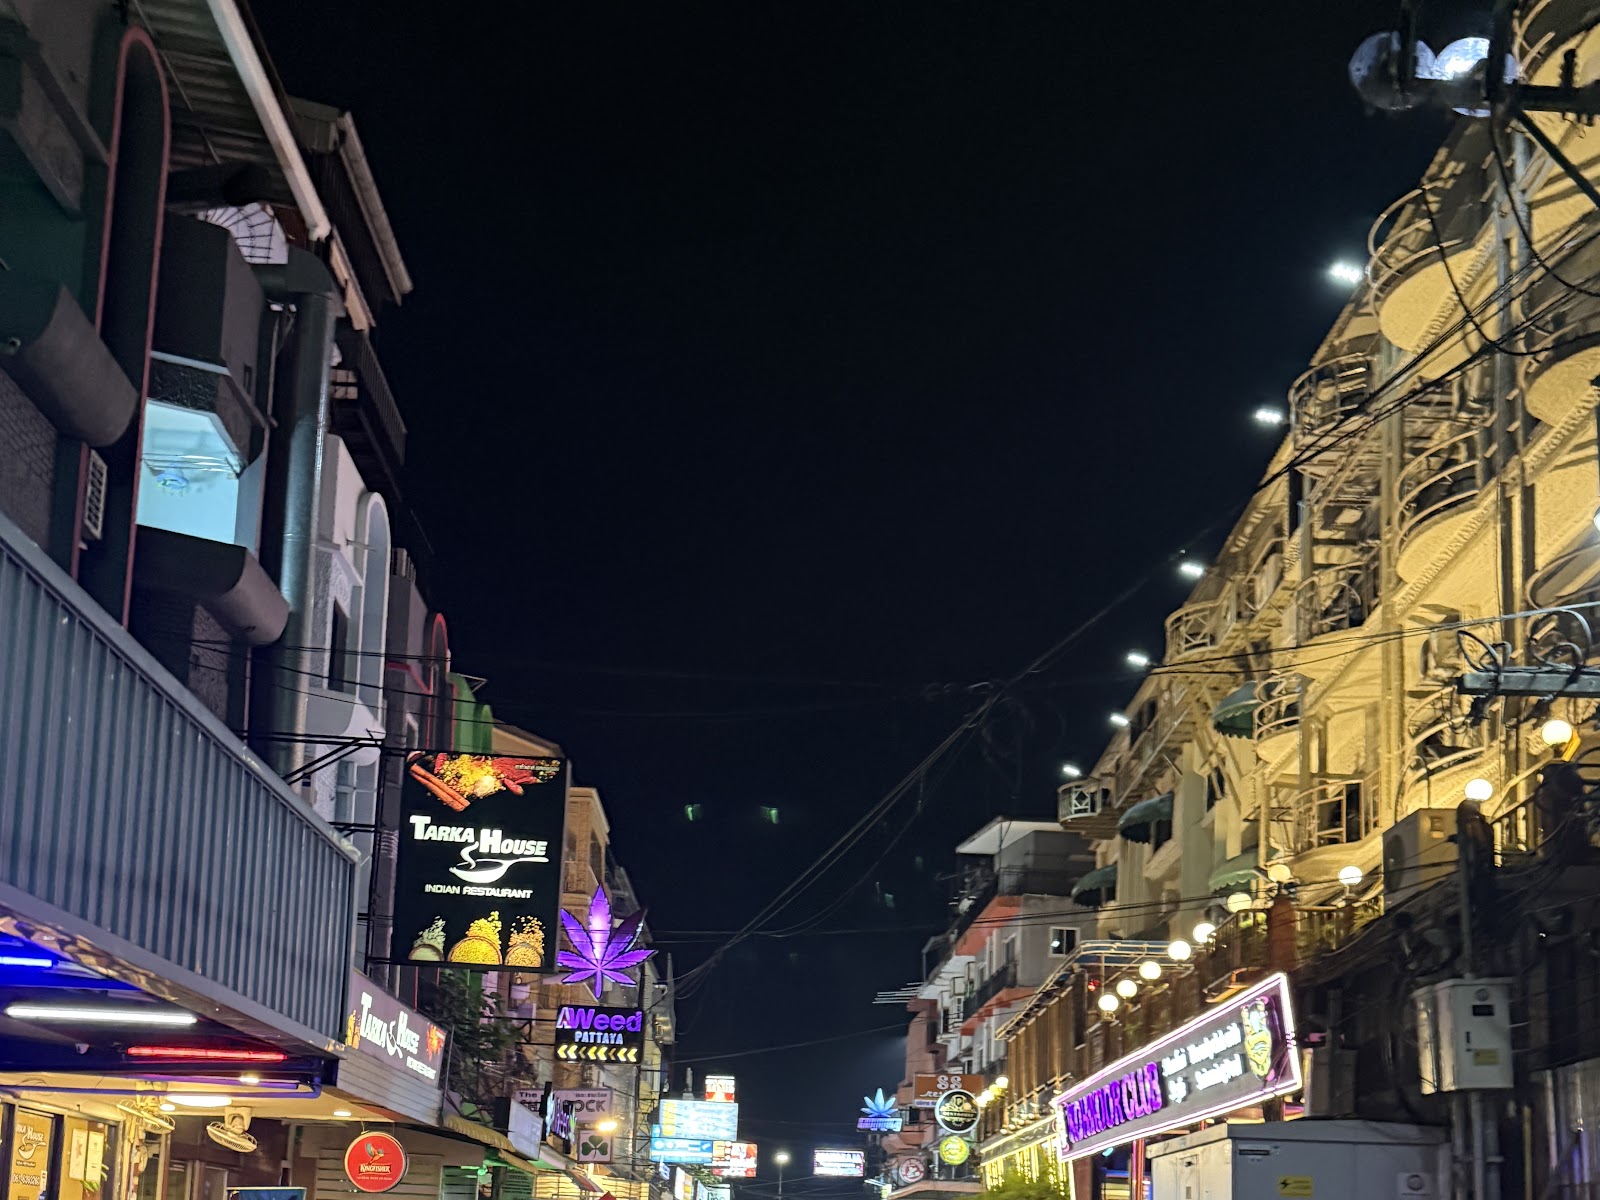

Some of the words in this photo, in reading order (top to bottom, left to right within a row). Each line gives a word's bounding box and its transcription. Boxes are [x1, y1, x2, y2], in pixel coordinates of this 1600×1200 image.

[409, 815, 475, 843] TARKA
[479, 828, 549, 856] HOUSE
[424, 884, 460, 895] INDIAN
[462, 886, 533, 899] RESTAURANT
[574, 1031, 624, 1045] PATTAYA
[1121, 1061, 1163, 1121] CLUB
